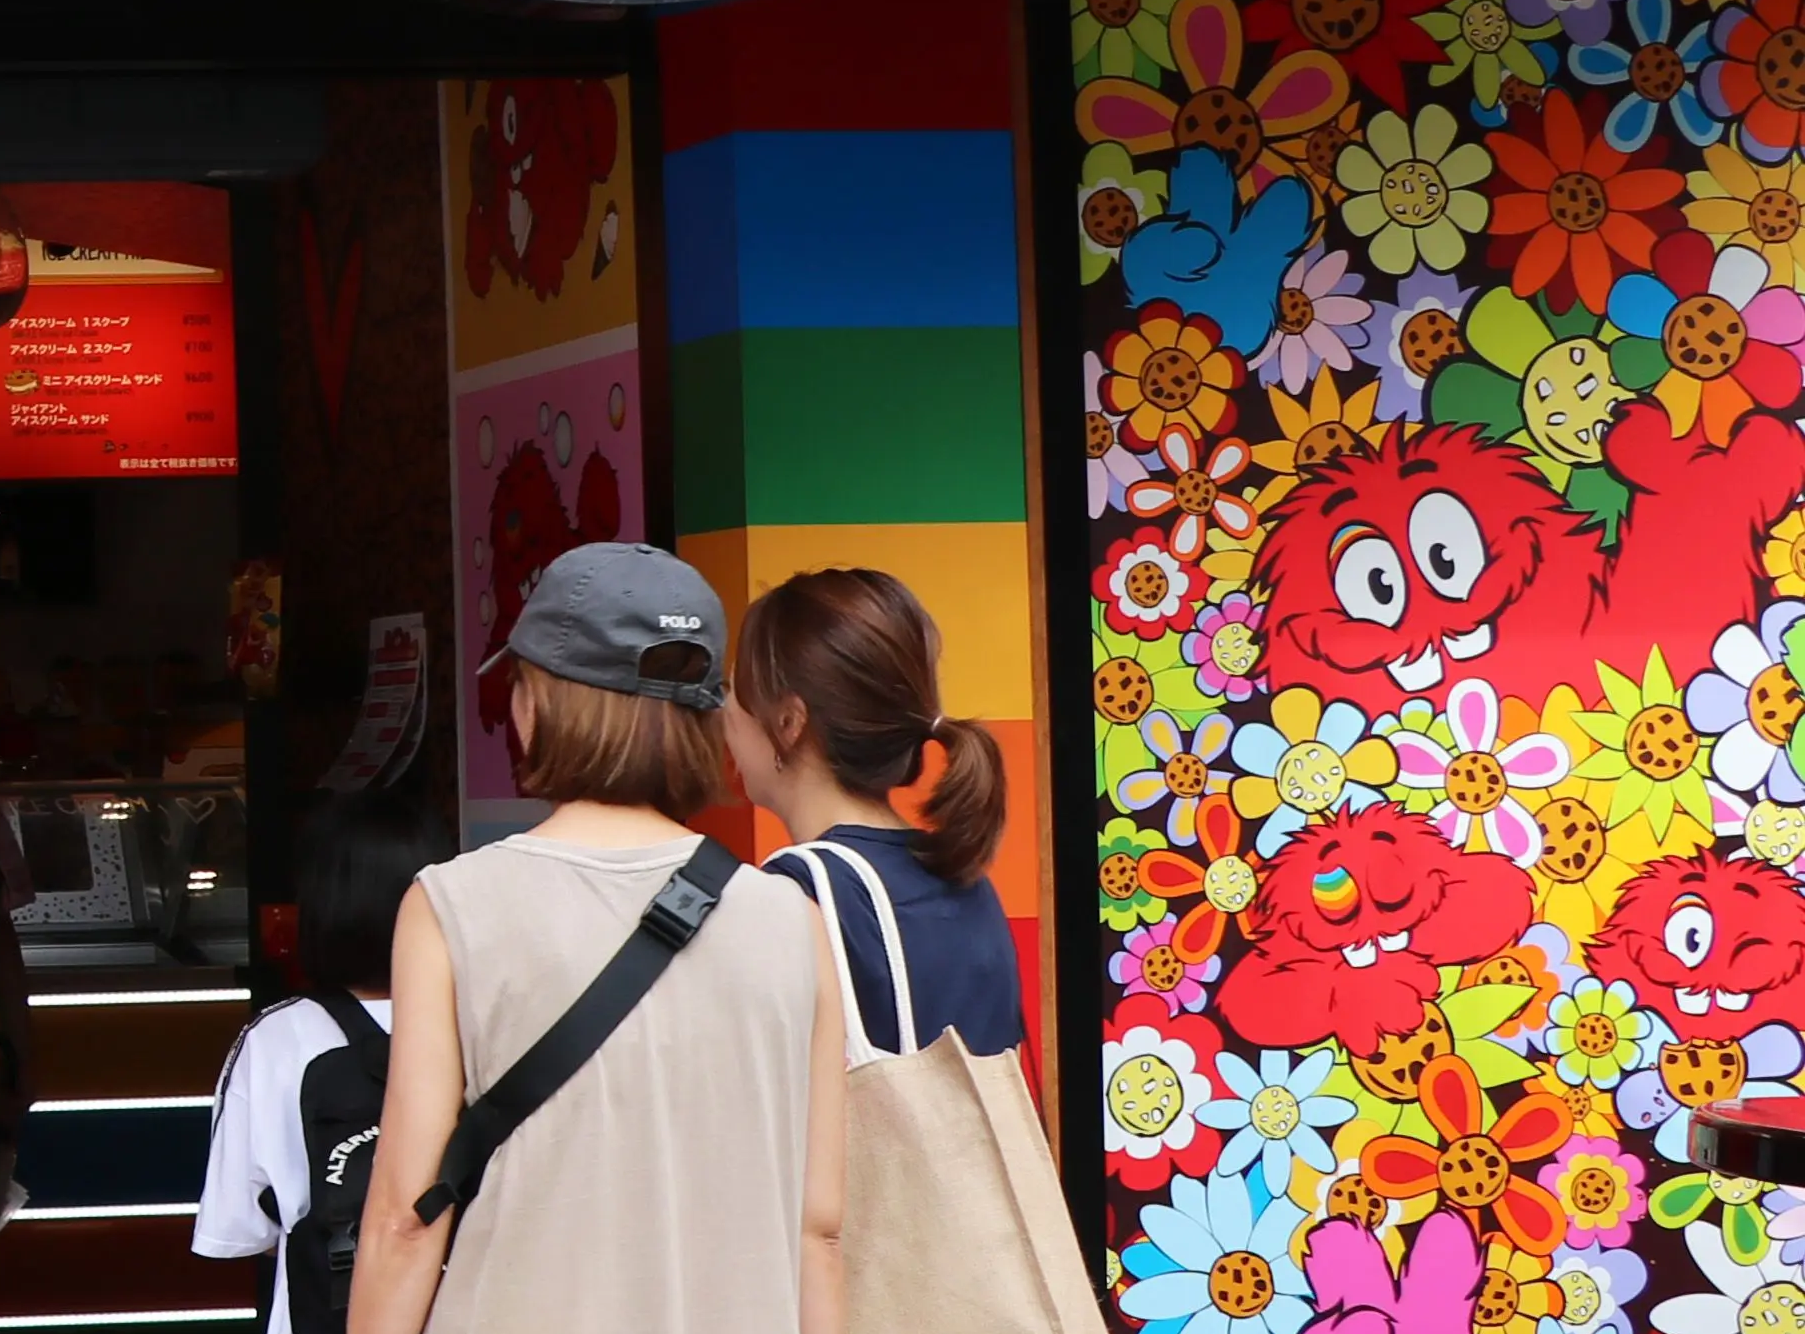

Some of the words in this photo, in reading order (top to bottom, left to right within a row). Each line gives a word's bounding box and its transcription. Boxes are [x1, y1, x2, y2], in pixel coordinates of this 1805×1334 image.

[9, 317, 77, 329] アイスクリーム
[10, 343, 78, 355] アイスクリーム
[43, 375, 62, 386] ミニ
[64, 374, 132, 386] アイスクリーム
[134, 373, 164, 386] サンド
[11, 404, 68, 414] ジャイアント
[11, 414, 79, 426] アイスクリーム
[81, 414, 110, 426] サンド
[658, 615, 702, 629] POLO
